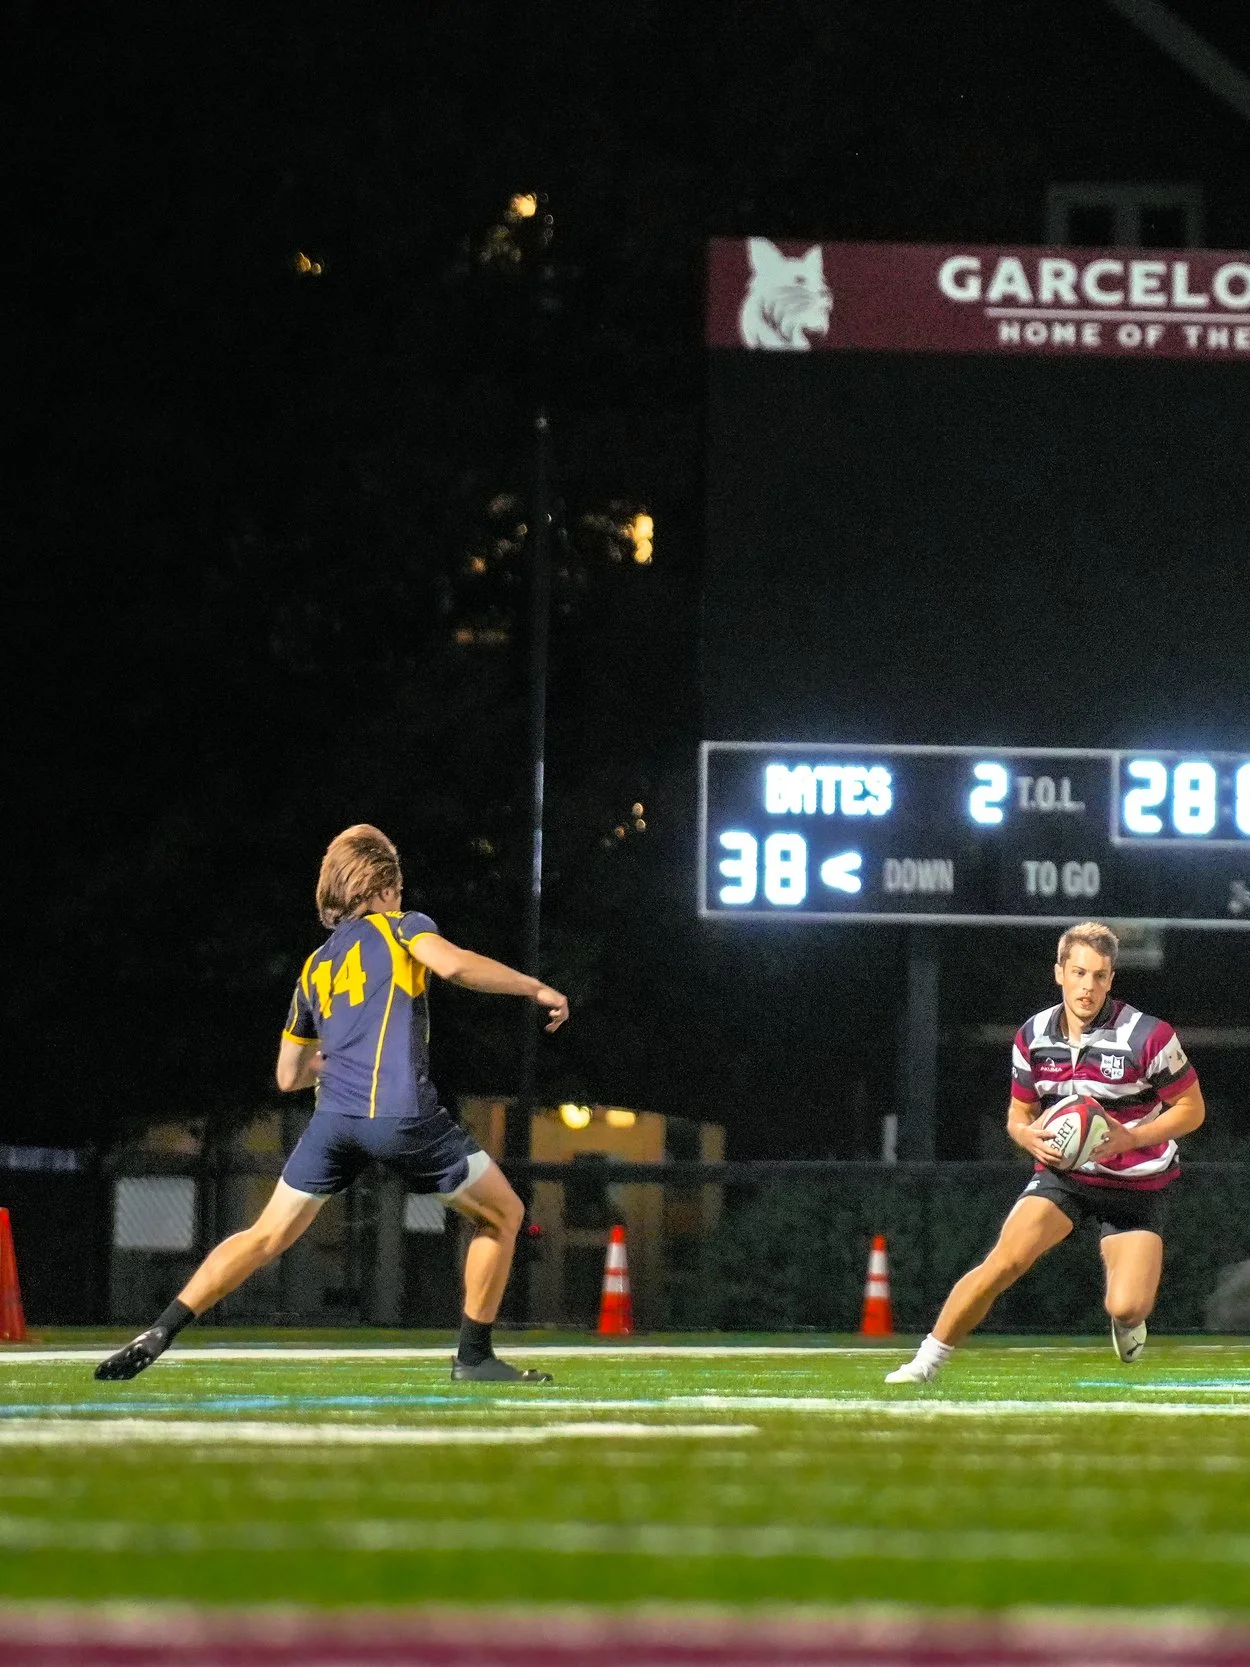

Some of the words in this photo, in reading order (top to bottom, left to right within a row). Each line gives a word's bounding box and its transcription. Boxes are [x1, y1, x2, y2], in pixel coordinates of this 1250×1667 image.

[1000, 320, 1101, 348] HOME
[1117, 323, 1165, 349] OF
[763, 762, 893, 817] BATES
[967, 761, 1010, 826] 2
[718, 830, 808, 905] 38
[884, 858, 954, 892] DOWN
[1023, 861, 1058, 896] TO
[1062, 861, 1100, 897] GO
[310, 939, 367, 1020] 14
[1051, 1118, 1074, 1151] BERT
